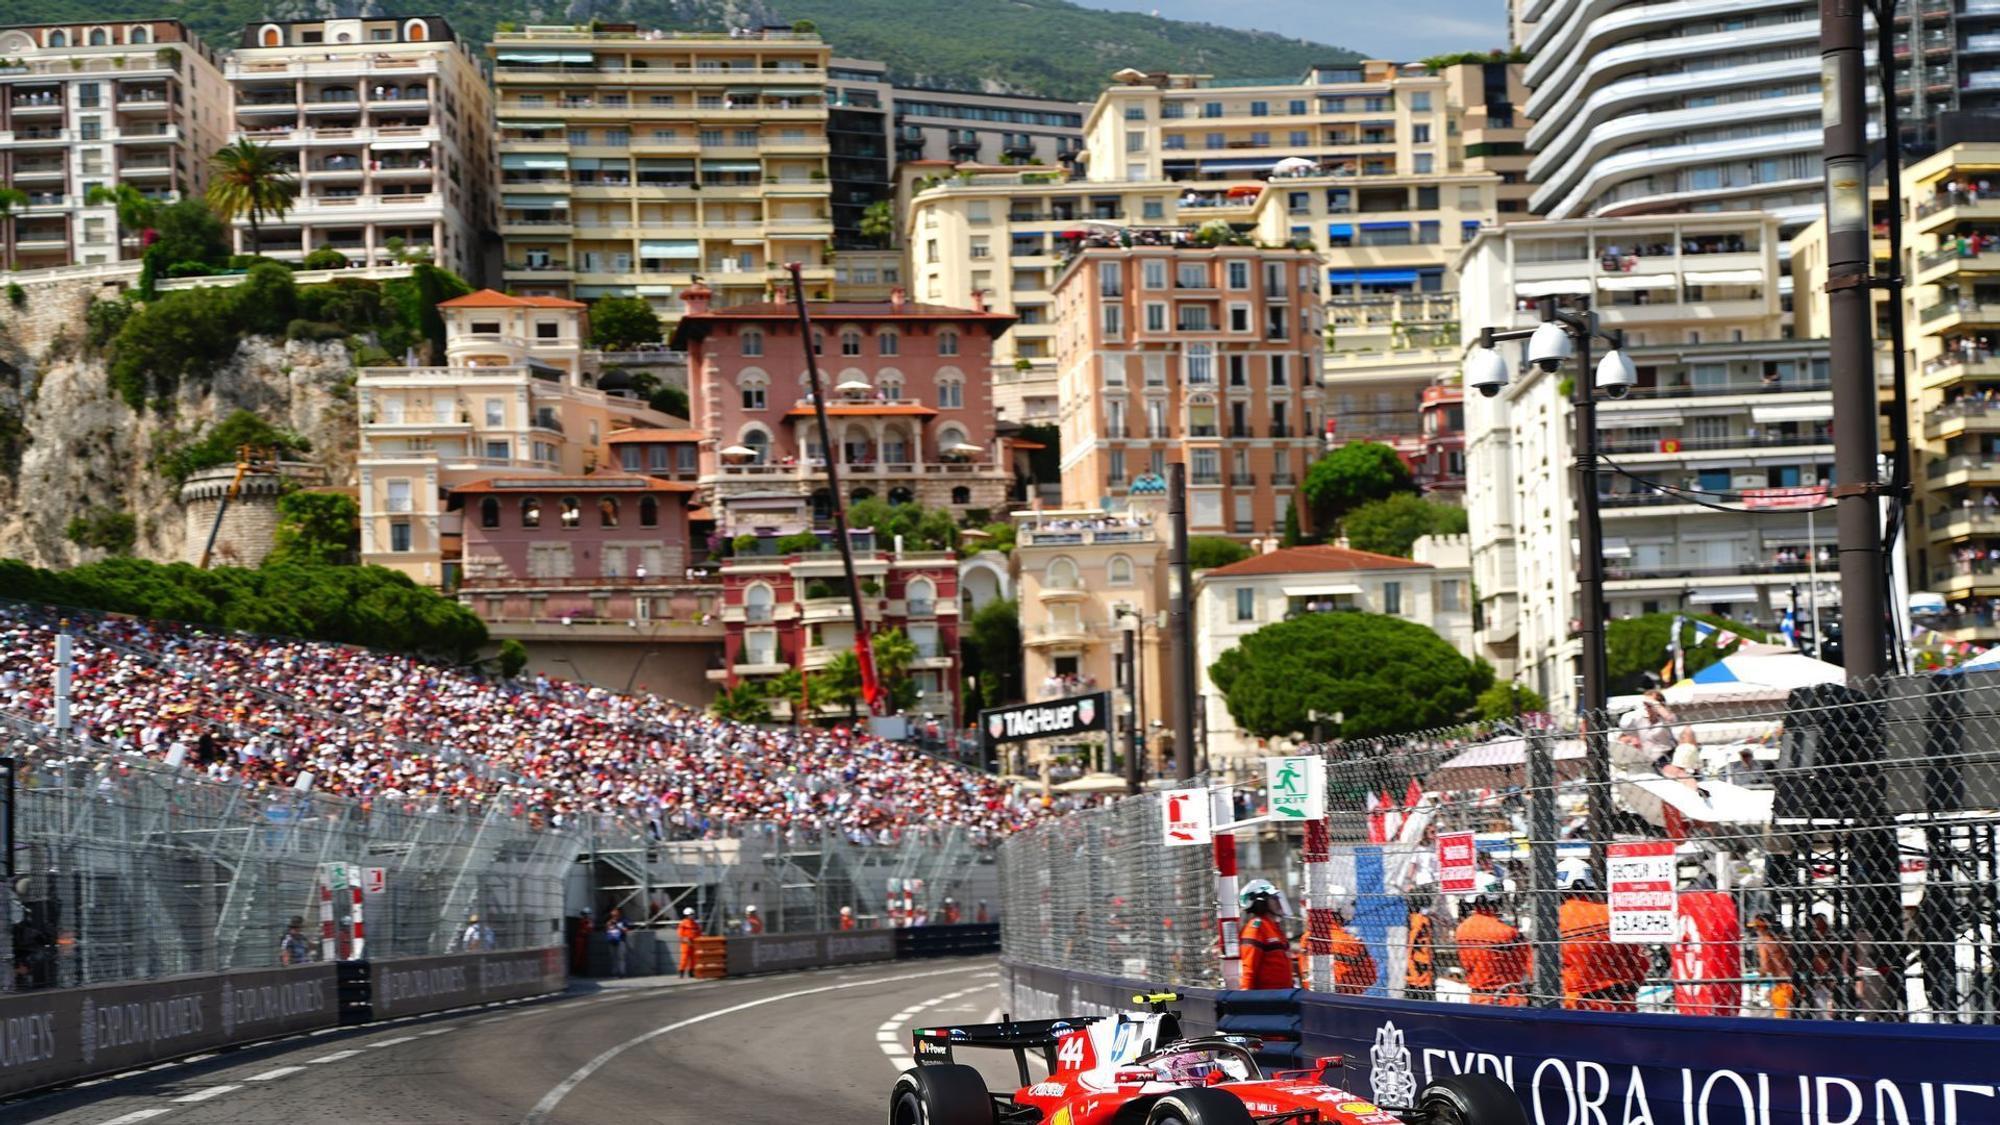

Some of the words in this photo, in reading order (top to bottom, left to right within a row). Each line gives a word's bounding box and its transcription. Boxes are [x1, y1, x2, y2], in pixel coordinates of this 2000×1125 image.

[1273, 796, 1308, 804] EXIT
[1169, 821, 1198, 829] FIRE
[98, 1002, 149, 1049] EXPLORA
[926, 1042, 946, 1054] V-Power
[1058, 1037, 1084, 1070] 44
[1256, 1104, 1278, 1112] MILLE
